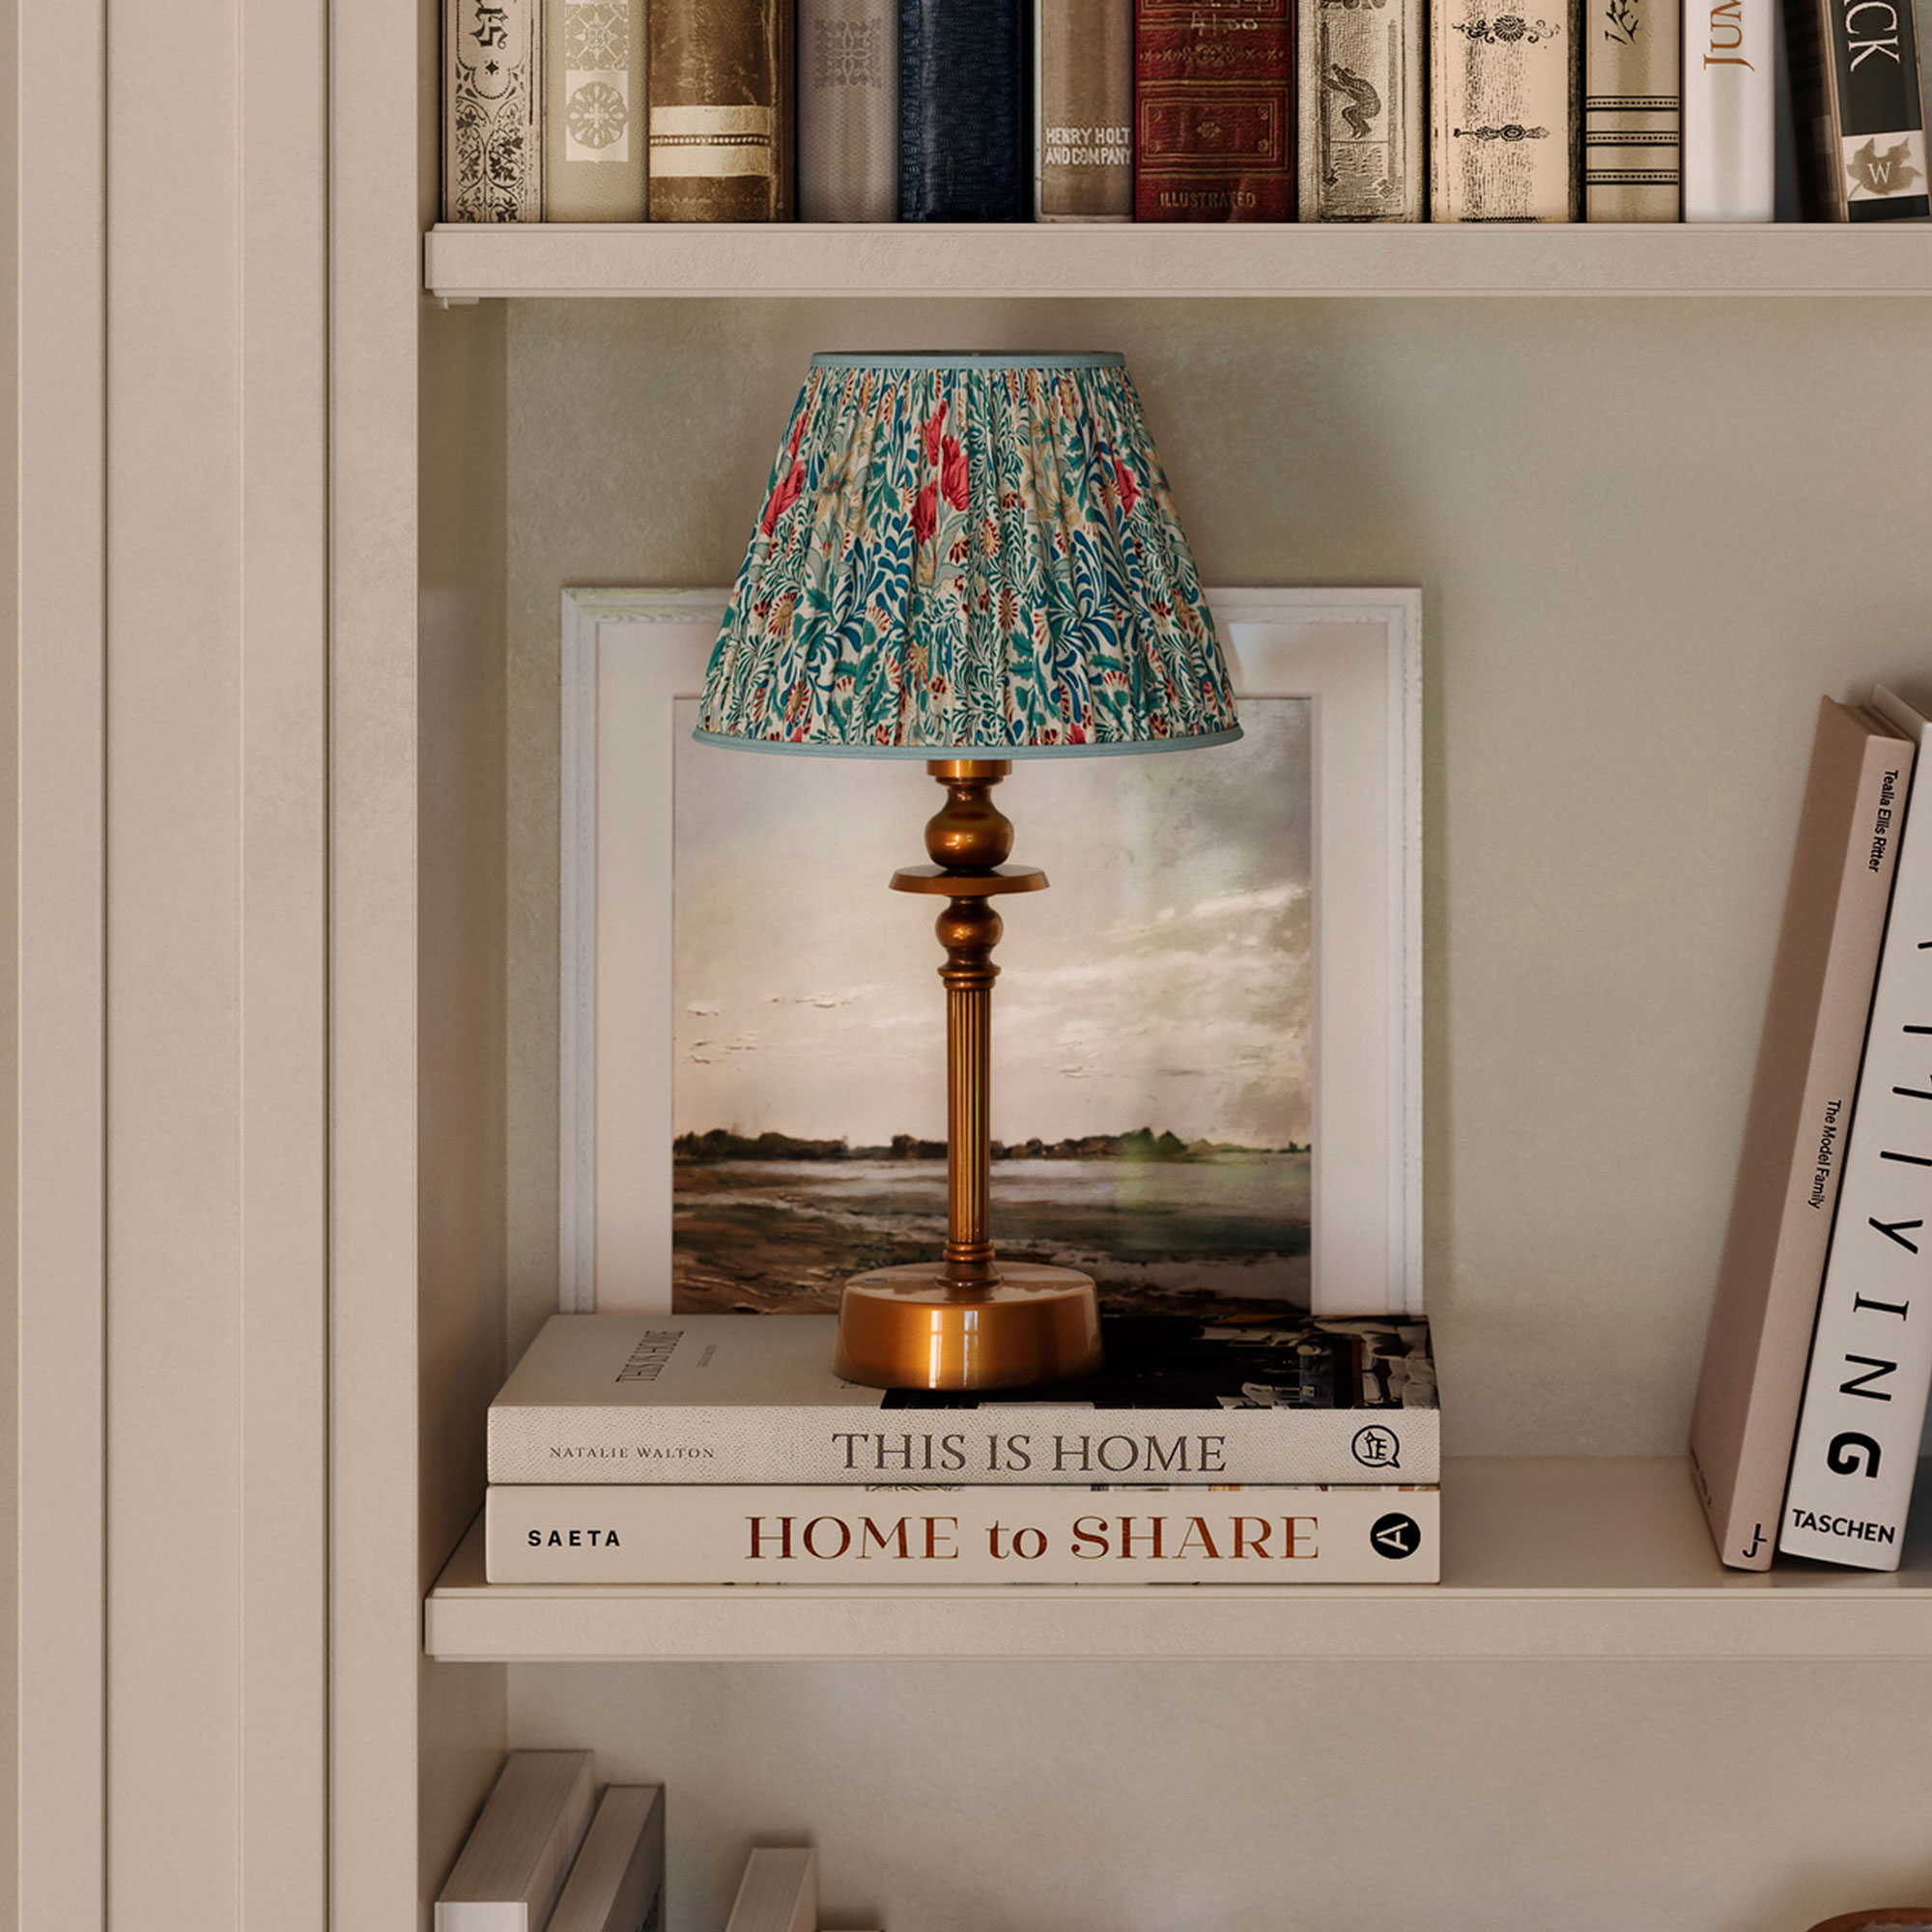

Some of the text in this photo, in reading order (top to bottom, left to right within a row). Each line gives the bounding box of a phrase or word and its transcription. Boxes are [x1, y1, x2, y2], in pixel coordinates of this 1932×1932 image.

[1843, 0, 1900, 72] CK
[1045, 128, 1131, 145] HENRY HOLT
[1867, 161, 1892, 185] W
[1159, 192, 1257, 208] ILLUSTRATED
[1874, 809, 1891, 835] Ellis
[1868, 836, 1887, 872] Ritter
[1808, 1100, 1841, 1209] The Model Family
[551, 1448, 715, 1459] NATALIE WALTON
[832, 1434, 1227, 1472] THIS IS HOME
[527, 1530, 620, 1547] SAETA
[745, 1516, 1320, 1560] HOME to SHARE
[1792, 1508, 1895, 1545] TASCHEN
